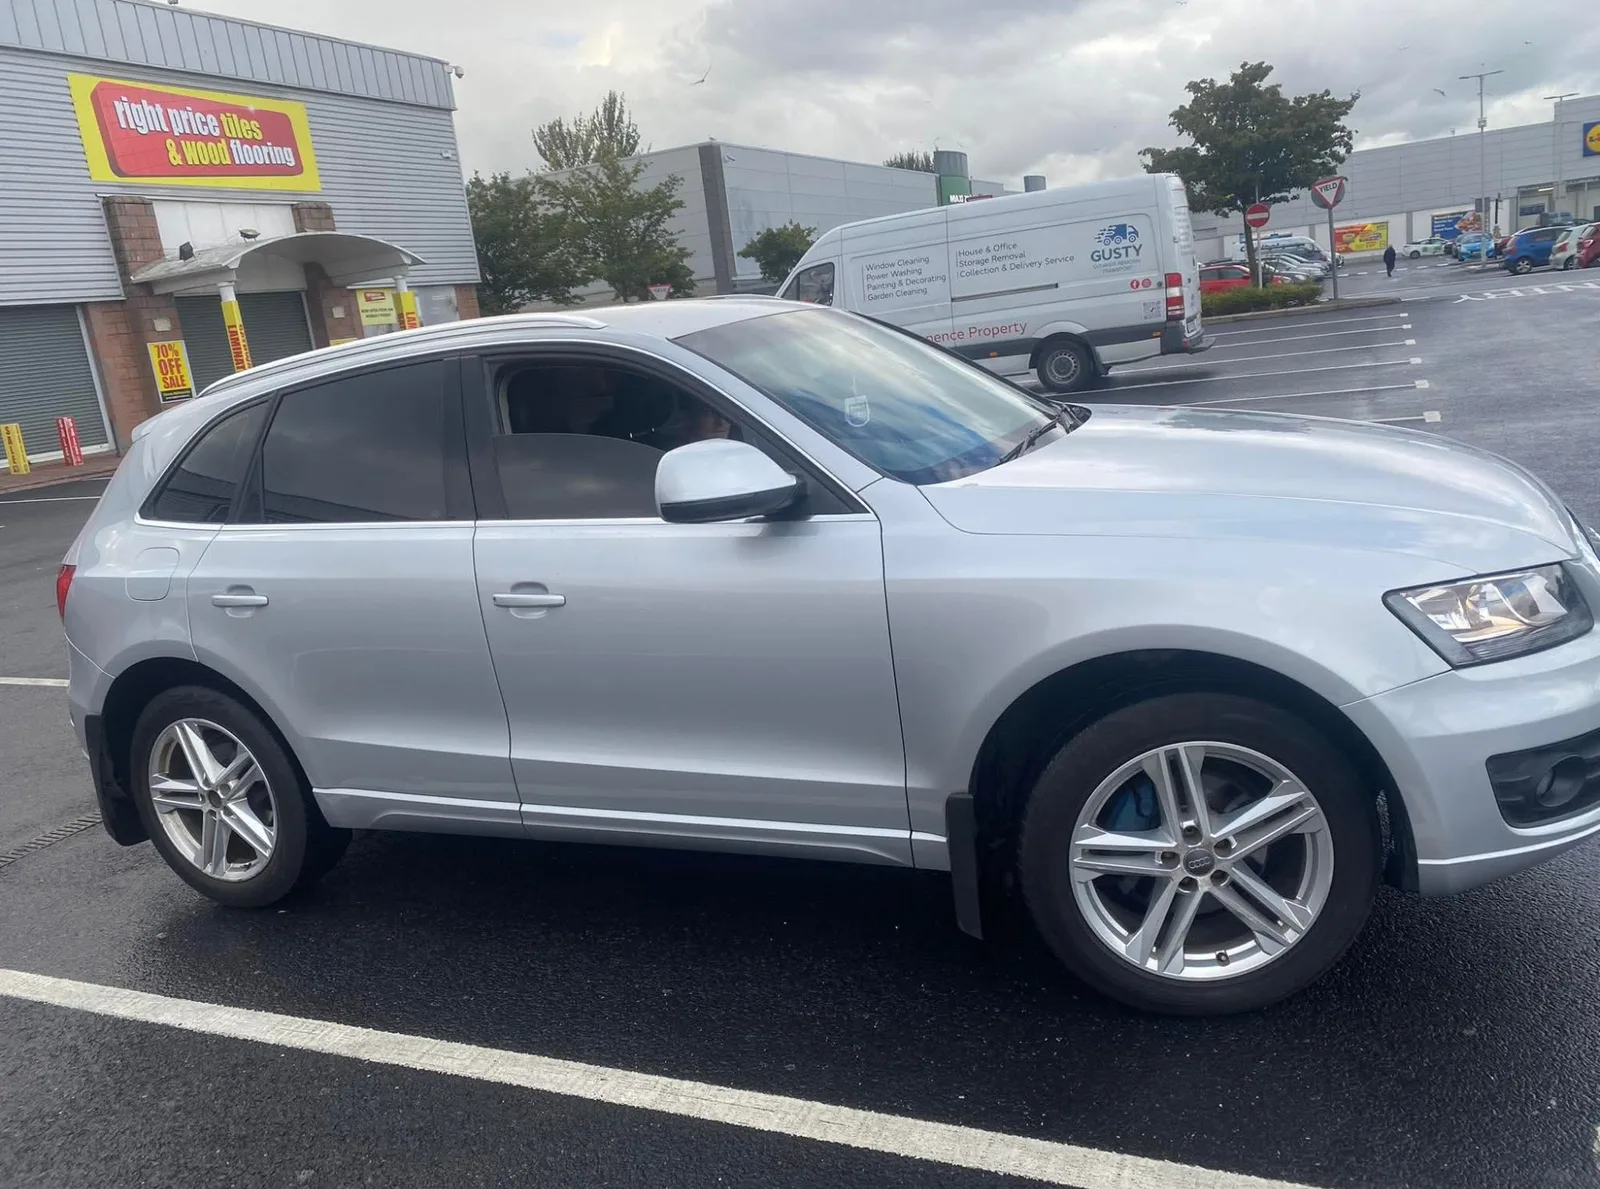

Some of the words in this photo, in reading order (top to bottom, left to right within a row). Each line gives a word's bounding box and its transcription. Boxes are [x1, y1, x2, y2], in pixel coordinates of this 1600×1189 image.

[113, 96, 169, 135] right
[167, 106, 221, 137] price
[219, 112, 263, 140] tiles
[165, 138, 182, 166] &
[181, 139, 231, 166] wood
[229, 139, 296, 168] flooring
[1320, 182, 1338, 193] YIELD
[958, 247, 984, 257] House
[985, 245, 992, 254] &
[993, 242, 1018, 252] Office
[1090, 243, 1143, 262] GUSTY
[865, 261, 896, 271] Window
[897, 256, 930, 267] Cleaning
[959, 257, 990, 268] Storage
[991, 250, 1026, 263] Removal
[959, 265, 1000, 278] Collection
[1001, 263, 1008, 272] &
[1009, 259, 1043, 271] Delivery
[1044, 255, 1075, 266] Service
[866, 272, 889, 282] Power
[890, 268, 923, 278] Washing
[867, 281, 897, 291] Painting
[898, 279, 904, 287] &
[905, 274, 947, 286] Decorating
[867, 291, 894, 301] Garden
[895, 287, 928, 298] Cleaning
[968, 322, 1028, 338] Property
[153, 344, 180, 359] 70%
[158, 358, 182, 376] OFF
[162, 375, 187, 389] SALE
[5, 426, 17, 465] SALE
